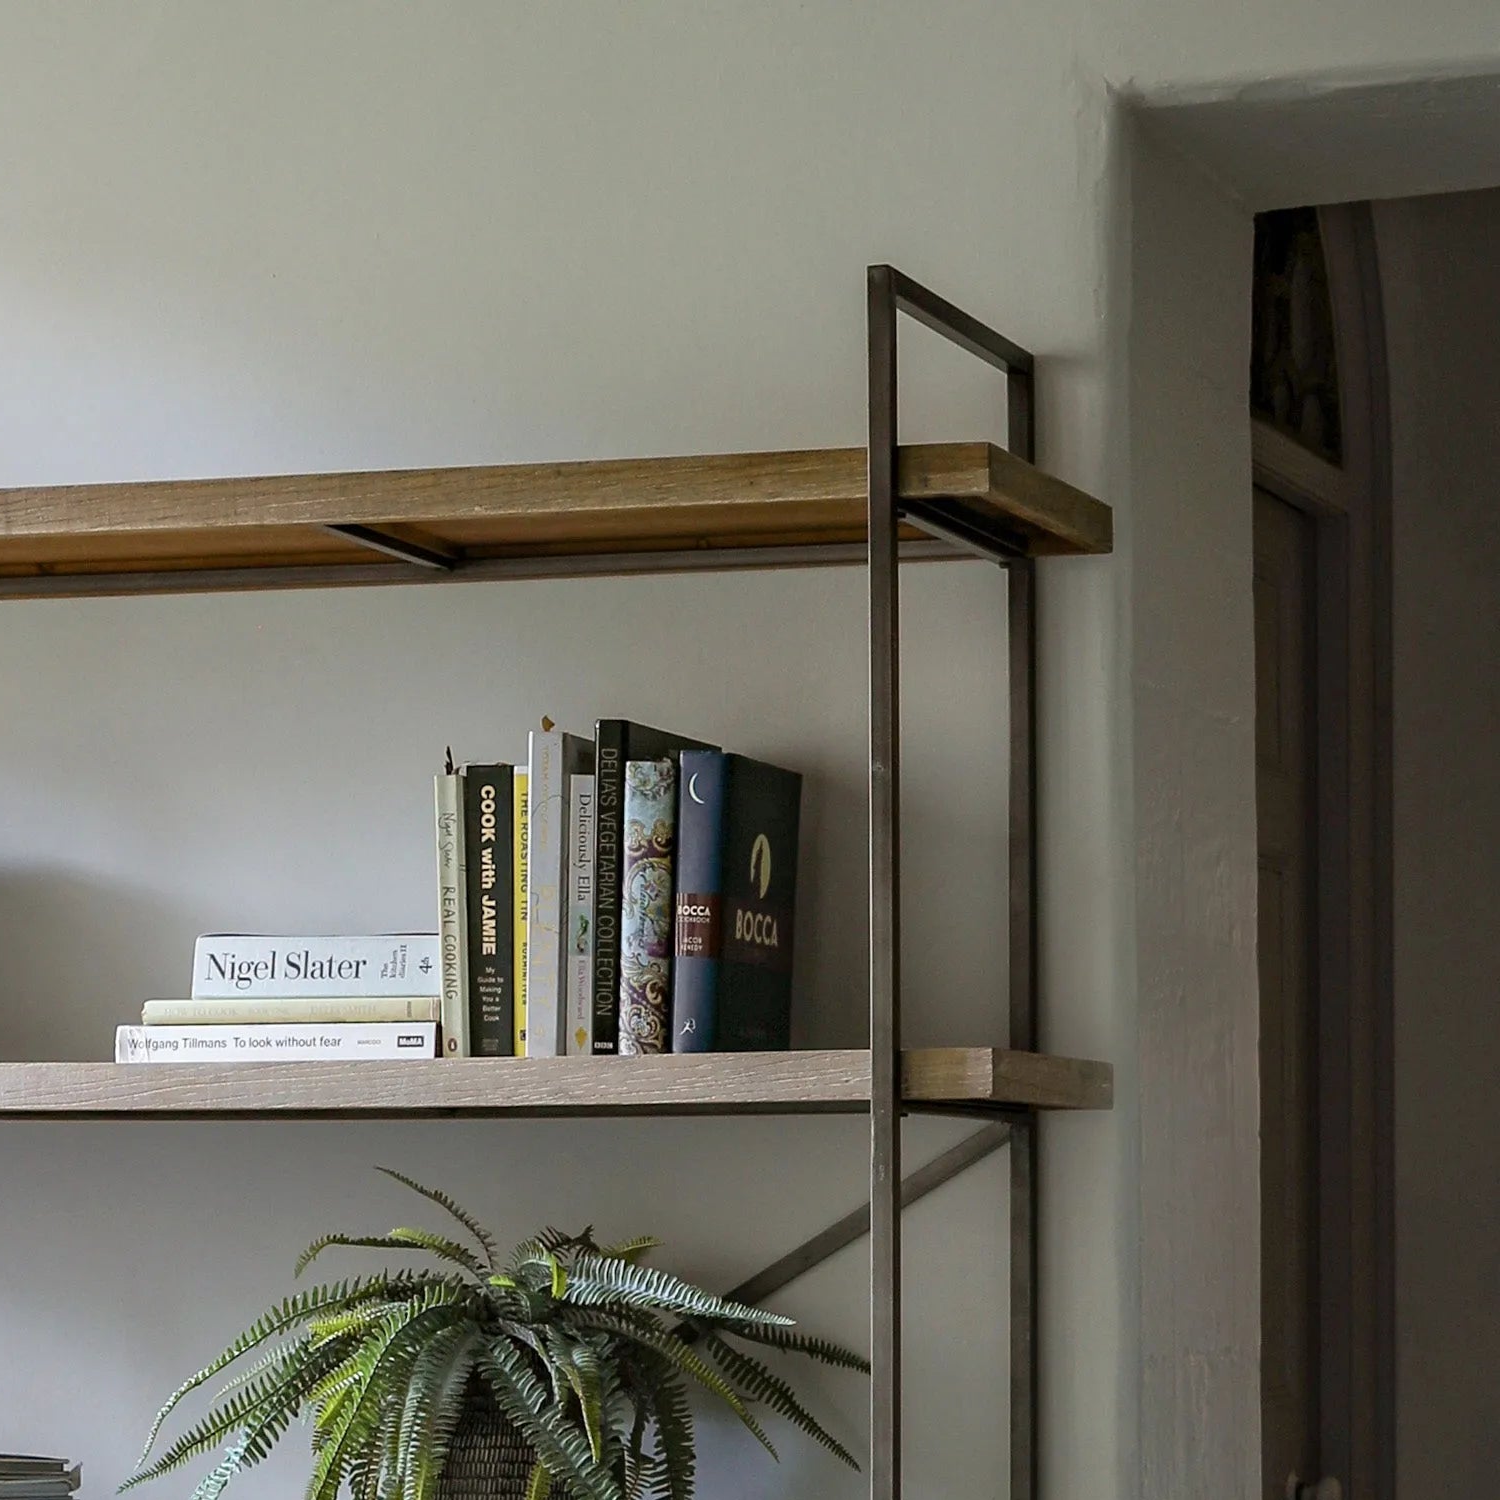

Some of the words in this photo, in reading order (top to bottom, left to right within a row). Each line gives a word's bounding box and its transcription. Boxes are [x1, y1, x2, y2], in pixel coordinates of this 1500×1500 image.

[599, 747, 618, 807] DELIA'S
[480, 784, 496, 843] COOK
[520, 792, 529, 817] THE
[573, 793, 592, 871] Deliciously
[480, 847, 497, 889] with
[520, 822, 529, 894] ROASTING
[598, 812, 618, 909] VEGETARIAN
[441, 886, 457, 924] REAL
[577, 876, 591, 902] Ella
[480, 895, 497, 956] JAMIE
[677, 904, 711, 916] BOCCA
[734, 908, 779, 948] BOCCA
[204, 950, 276, 990] Nigel
[284, 951, 367, 981] Slater
[443, 934, 459, 1000] COOKING
[484, 966, 496, 975] My
[596, 915, 615, 1016] COLLECTION
[127, 1037, 179, 1051] Wolfgang
[182, 1036, 228, 1048] Tillmans
[233, 1036, 246, 1048] To
[248, 1035, 273, 1048] look
[275, 1035, 318, 1048] without
[318, 1035, 342, 1047] fear
